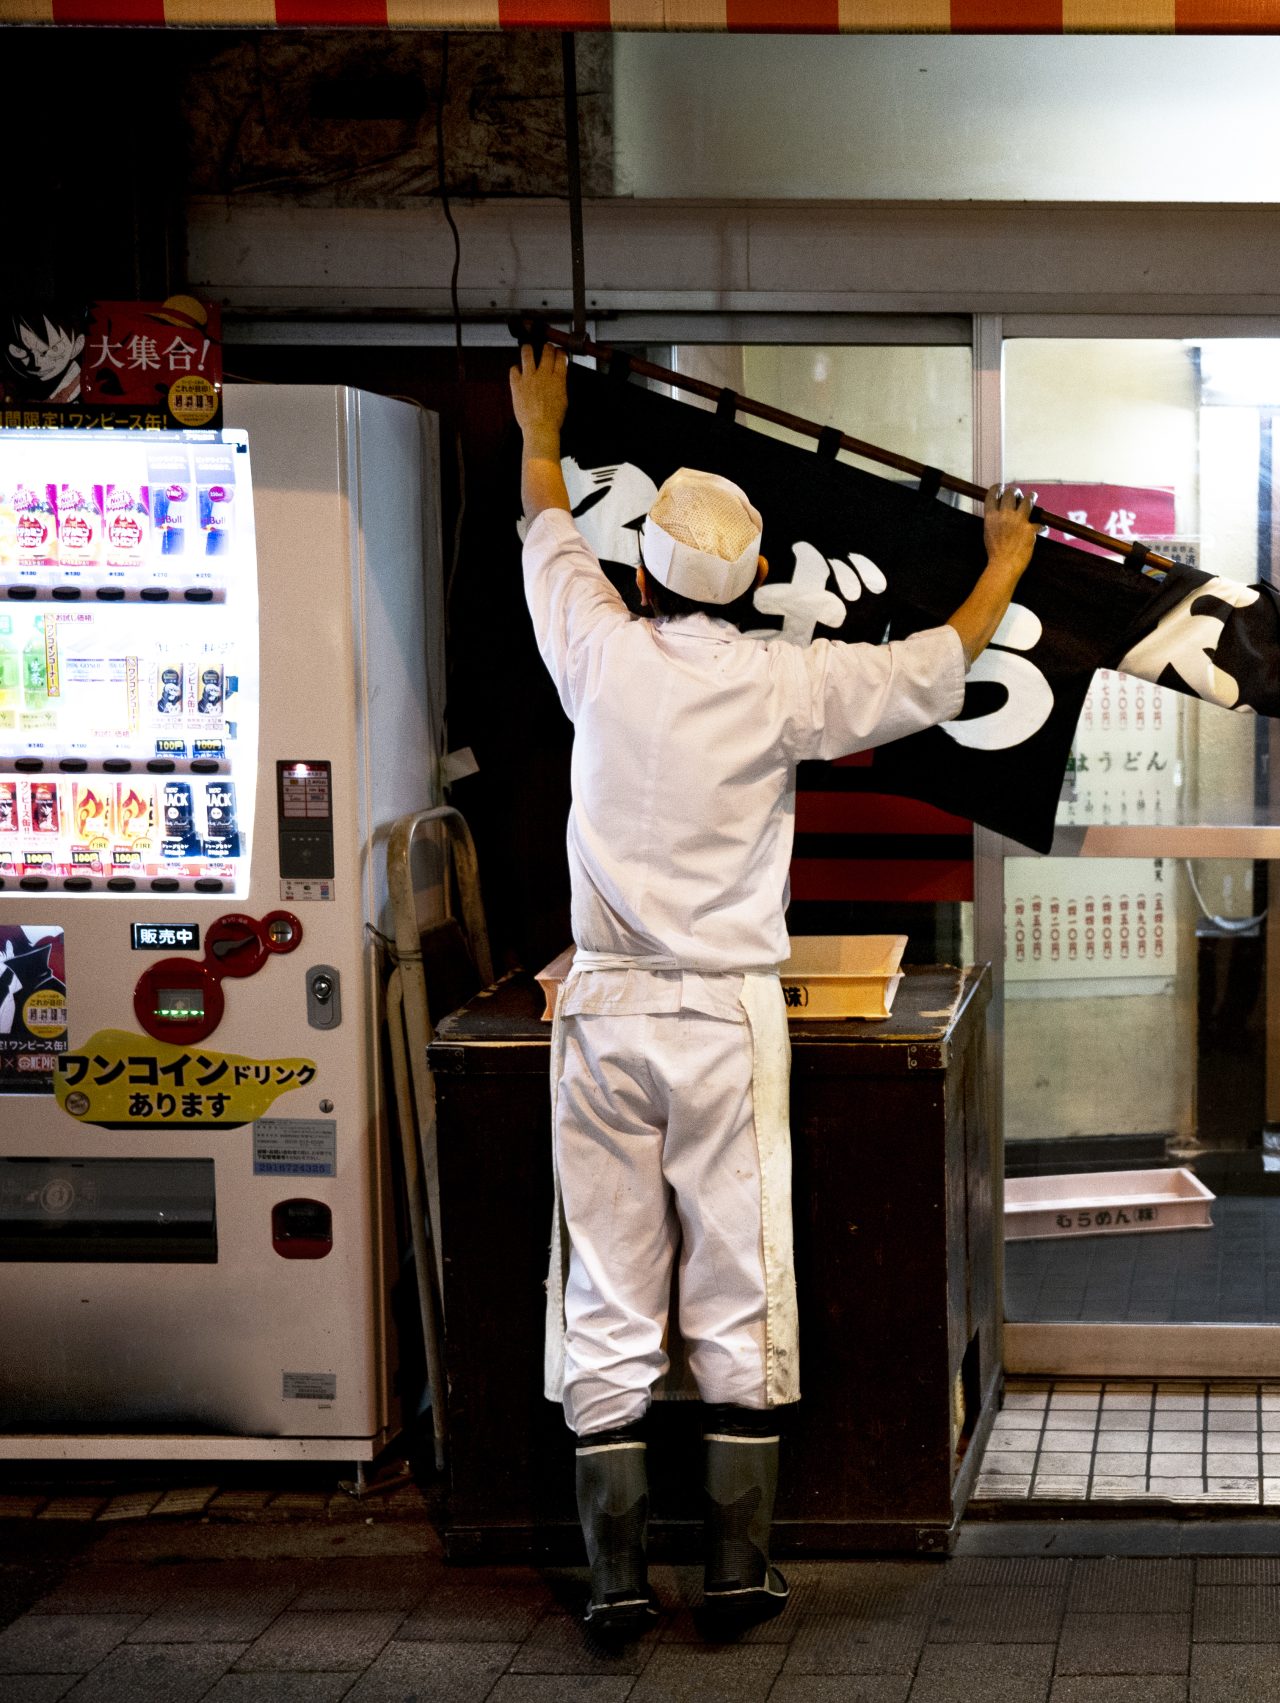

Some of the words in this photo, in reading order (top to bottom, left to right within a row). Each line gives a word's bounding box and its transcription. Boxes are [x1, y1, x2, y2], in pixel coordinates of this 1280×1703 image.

[90, 335, 211, 371] 大集合!
[140, 928, 193, 945] 販売中
[58, 1053, 317, 1087] ワンコインドリンク
[128, 1093, 231, 1117] あります
